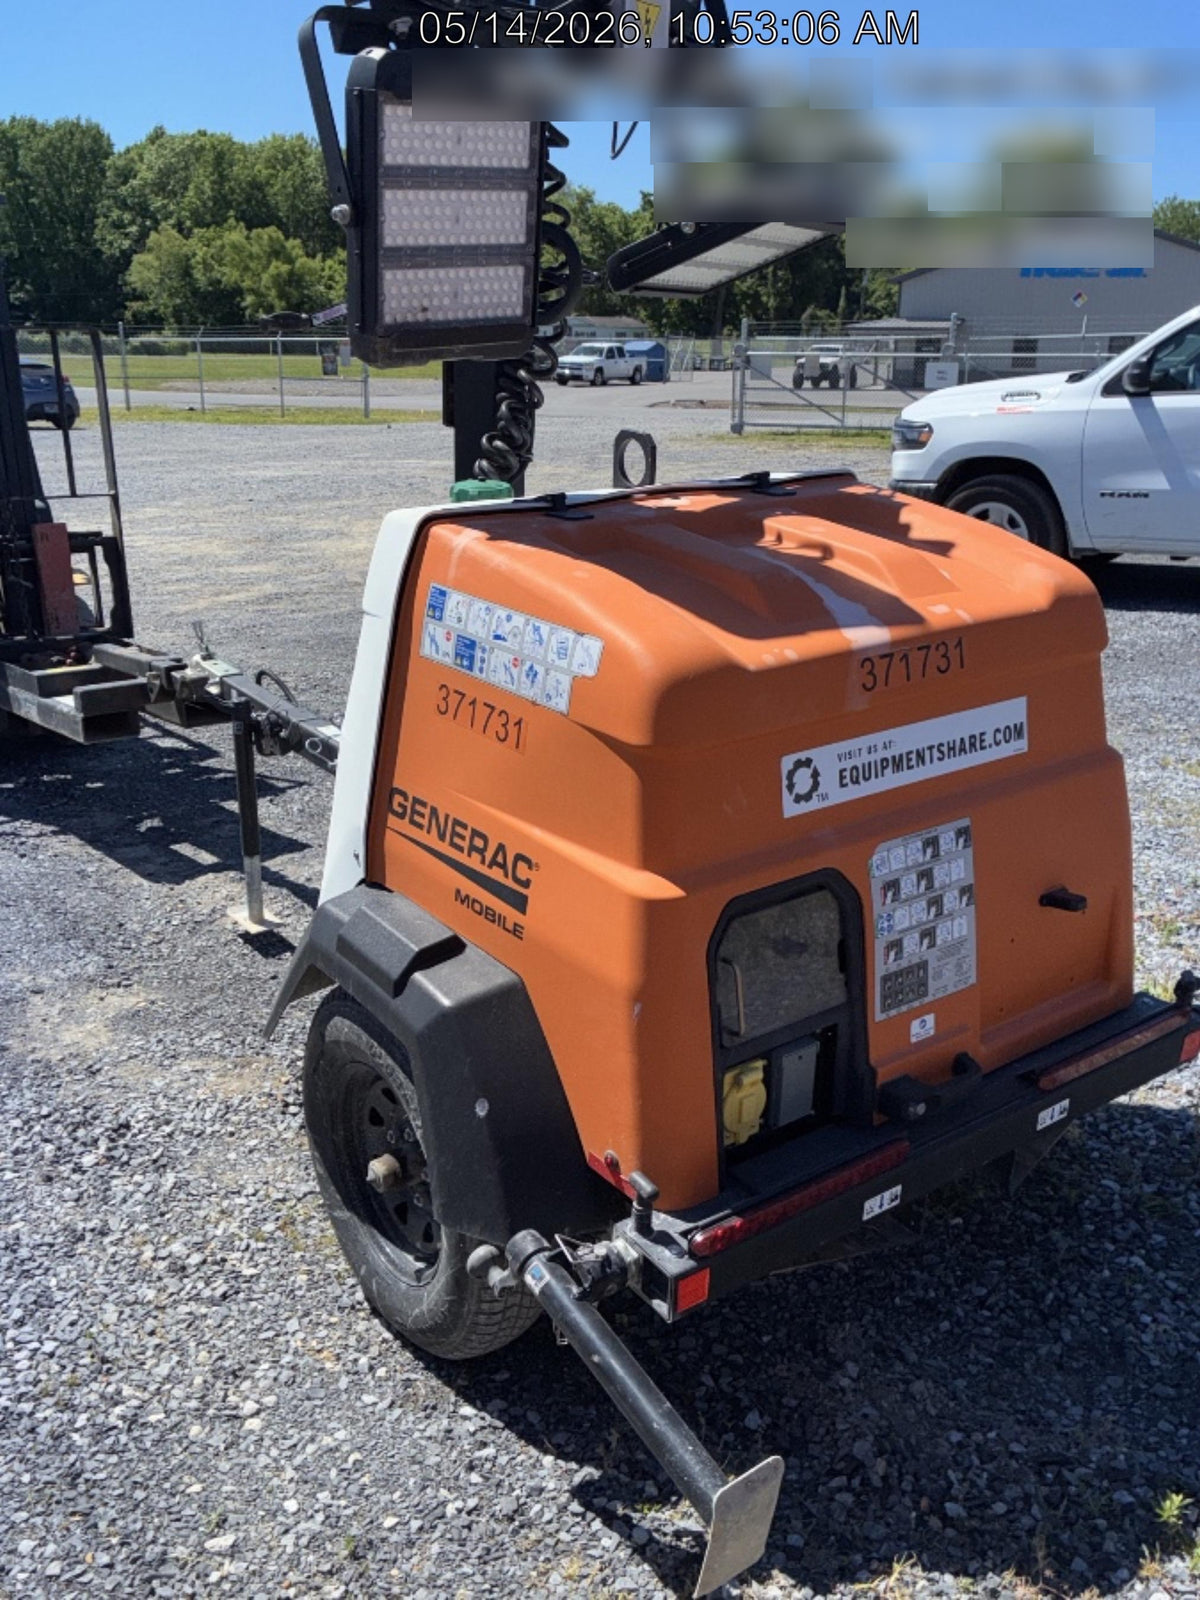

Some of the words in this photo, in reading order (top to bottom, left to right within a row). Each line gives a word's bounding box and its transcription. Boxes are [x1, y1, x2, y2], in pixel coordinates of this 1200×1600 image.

[860, 637, 965, 692] 371731
[436, 684, 524, 749] 371731
[837, 746, 862, 763] VISIT
[866, 742, 878, 756] US
[838, 721, 1025, 789] EQUIPMENTSHARE.COM
[388, 786, 534, 890] GENERAC
[454, 888, 525, 941] MOBILE
